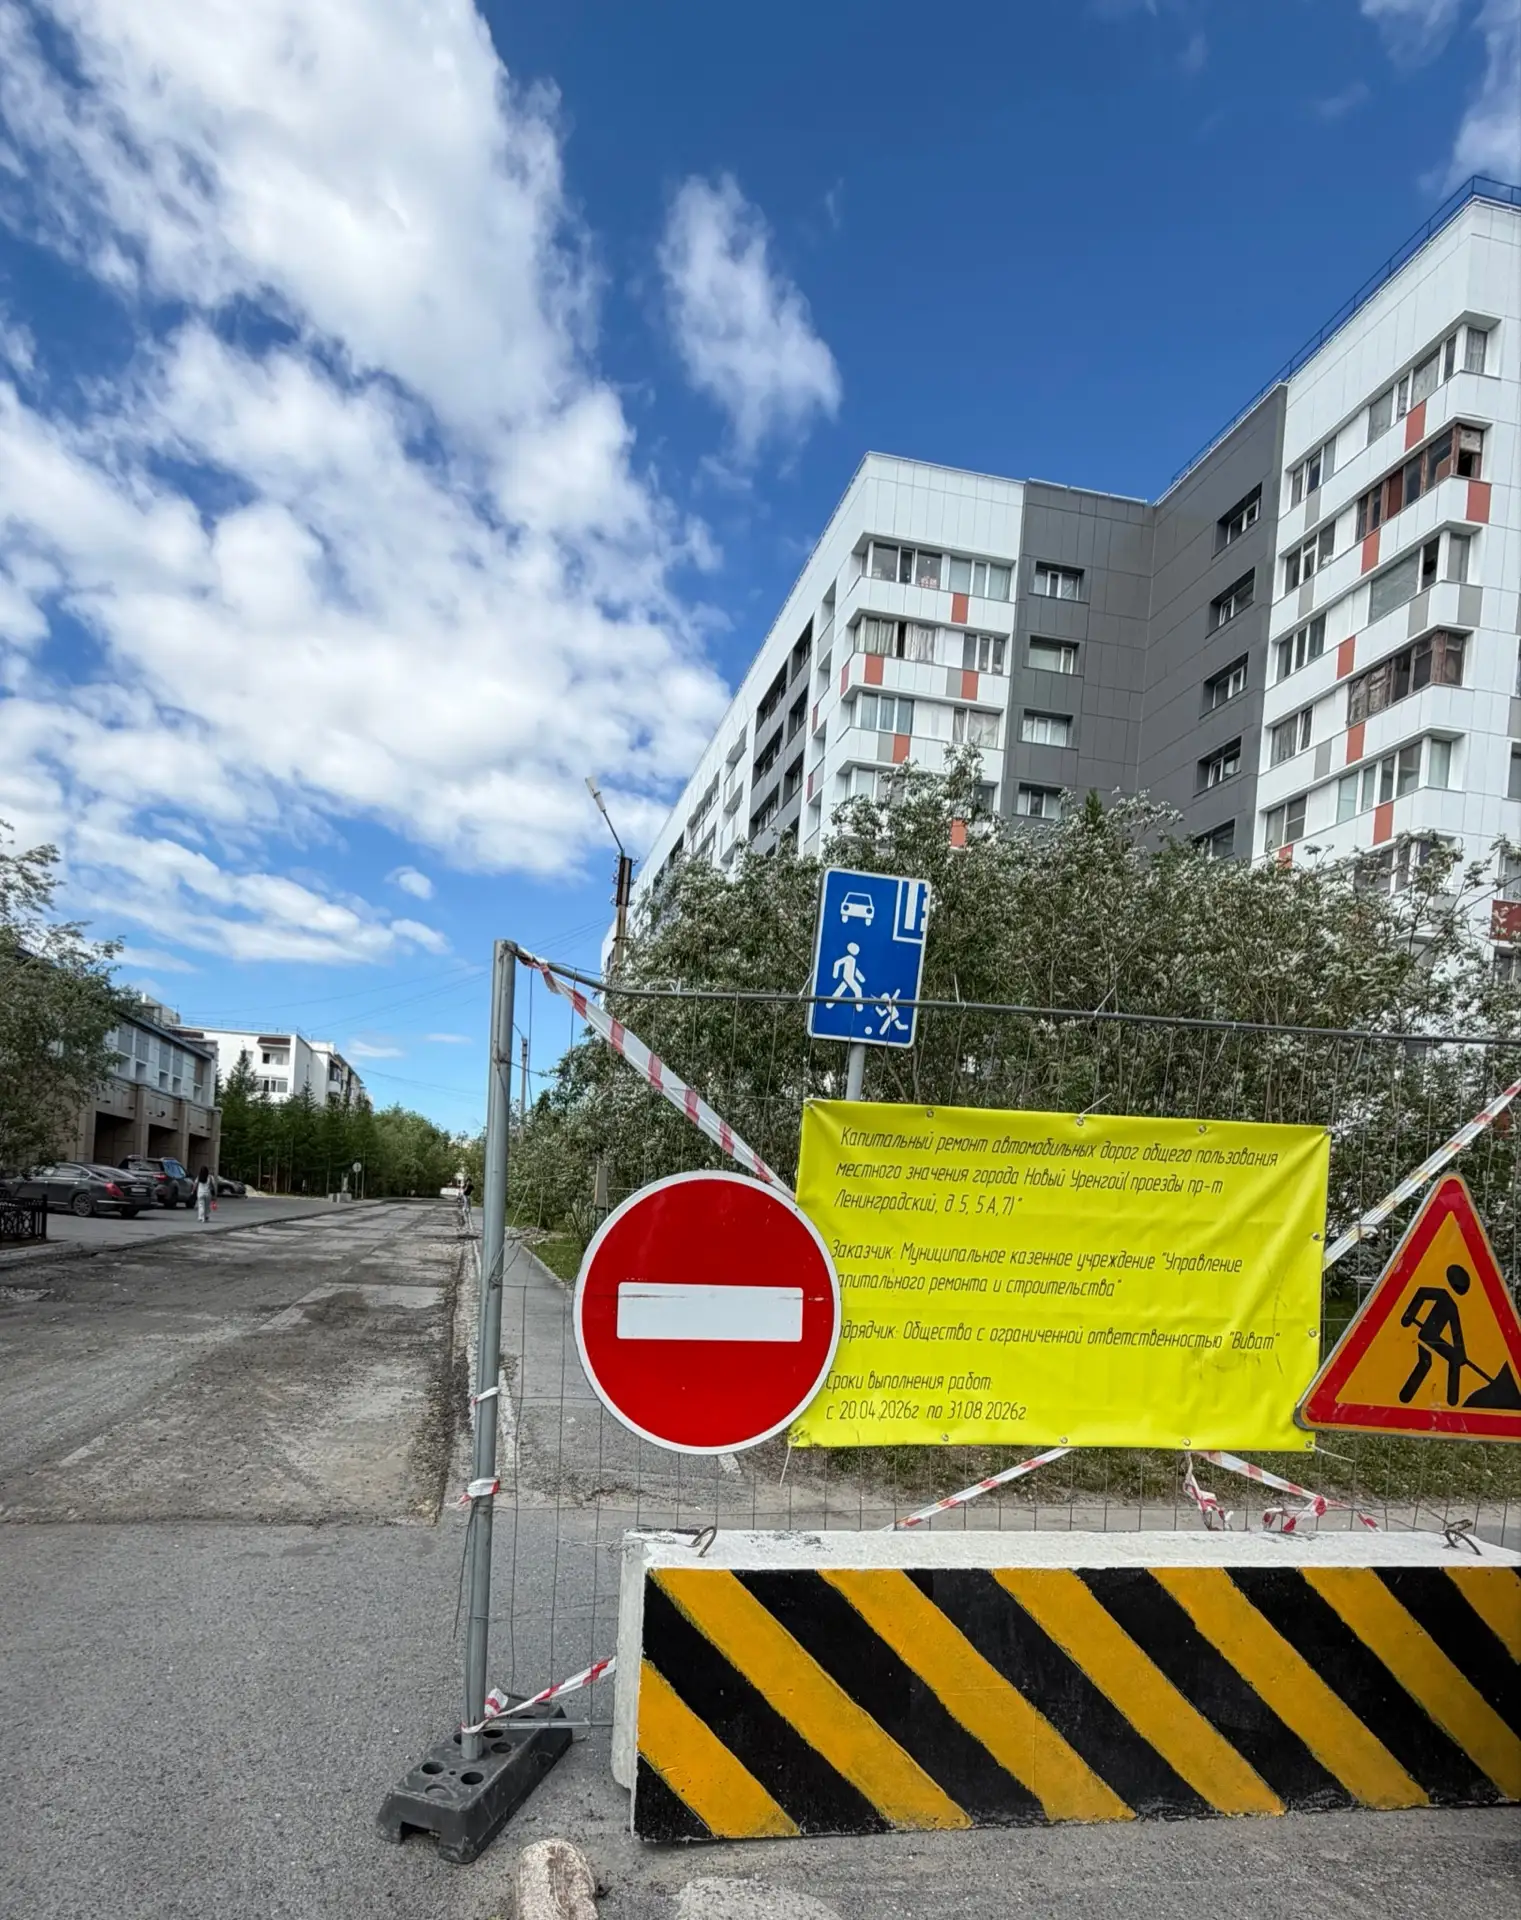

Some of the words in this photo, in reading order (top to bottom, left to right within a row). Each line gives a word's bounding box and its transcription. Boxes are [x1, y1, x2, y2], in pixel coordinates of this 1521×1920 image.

[840, 1126, 934, 1151] Капитальный
[935, 1135, 988, 1154] ремонт
[991, 1135, 1097, 1158] автомобильных
[1100, 1140, 1139, 1164] дорог
[1142, 1143, 1193, 1164] общего
[1195, 1147, 1278, 1167] пользования
[835, 1162, 902, 1180] местного
[905, 1166, 969, 1182] значения
[972, 1166, 1020, 1188] города
[1023, 1168, 1066, 1188] Новый
[1187, 1179, 1224, 1197] пр-т
[834, 1189, 938, 1214] Ленинградский,
[900, 1242, 1006, 1266] Муниципальное
[1009, 1250, 1073, 1267] казенное
[1076, 1251, 1156, 1272] учреждение
[1161, 1252, 1243, 1275] "Управление
[838, 1273, 926, 1290] апитального
[928, 1276, 988, 1295] ремонта
[992, 1279, 1002, 1293] и
[1005, 1278, 1122, 1298] строительства"
[903, 1320, 972, 1342] Общество
[976, 1327, 985, 1341] с
[989, 1325, 1083, 1347] ограниченной
[1087, 1327, 1222, 1349] ответственностью
[1229, 1331, 1280, 1350] "Виват"
[825, 1370, 864, 1394] Сроки
[867, 1370, 944, 1390] выполнения
[826, 1404, 834, 1420] с
[926, 1405, 943, 1419] по
